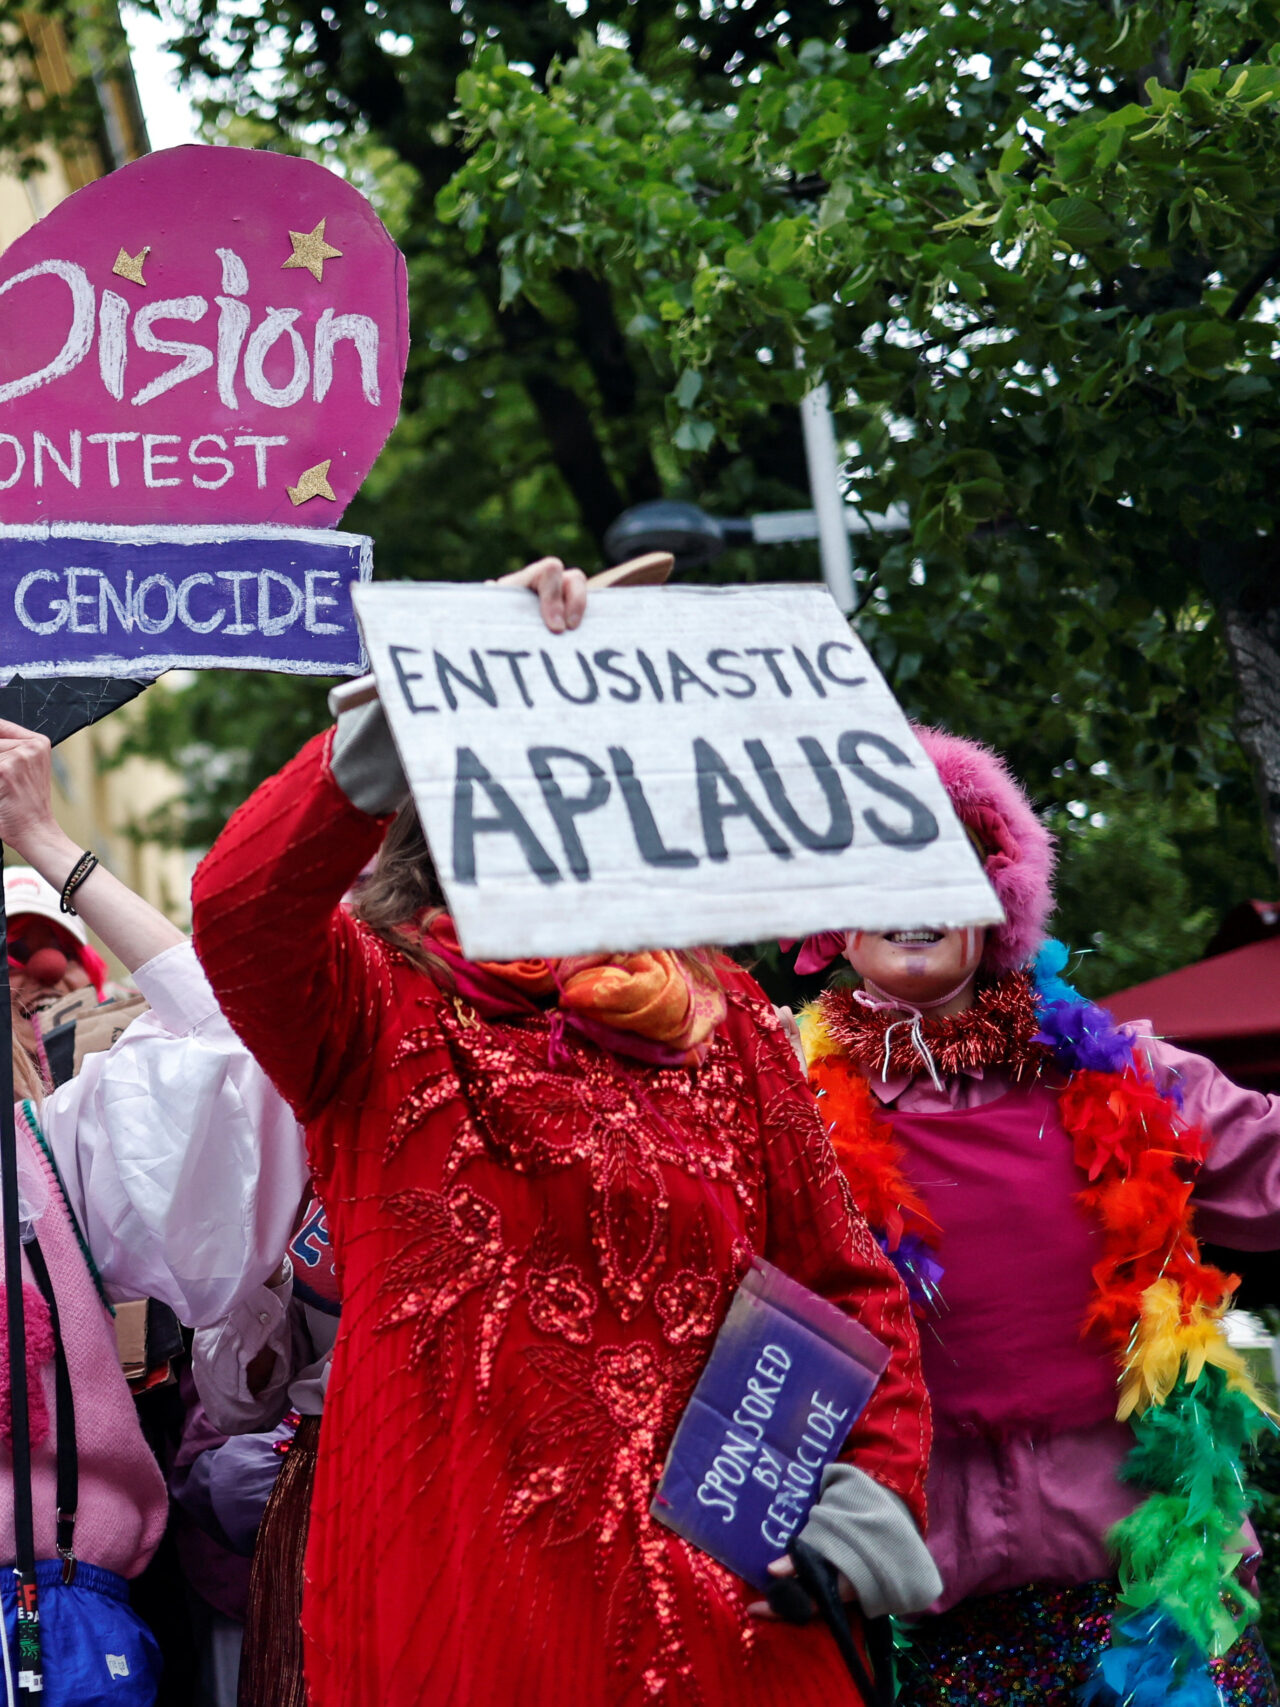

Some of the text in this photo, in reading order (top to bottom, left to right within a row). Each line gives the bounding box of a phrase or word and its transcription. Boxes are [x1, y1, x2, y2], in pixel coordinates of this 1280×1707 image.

[14, 567, 346, 636] GENOCIDE
[388, 640, 867, 714] ENTUSIASTIC
[451, 729, 940, 886] APLAUS
[696, 1343, 792, 1522] SPONSORED
[751, 1447, 783, 1490] BY
[761, 1390, 849, 1548] GENOCIDE
